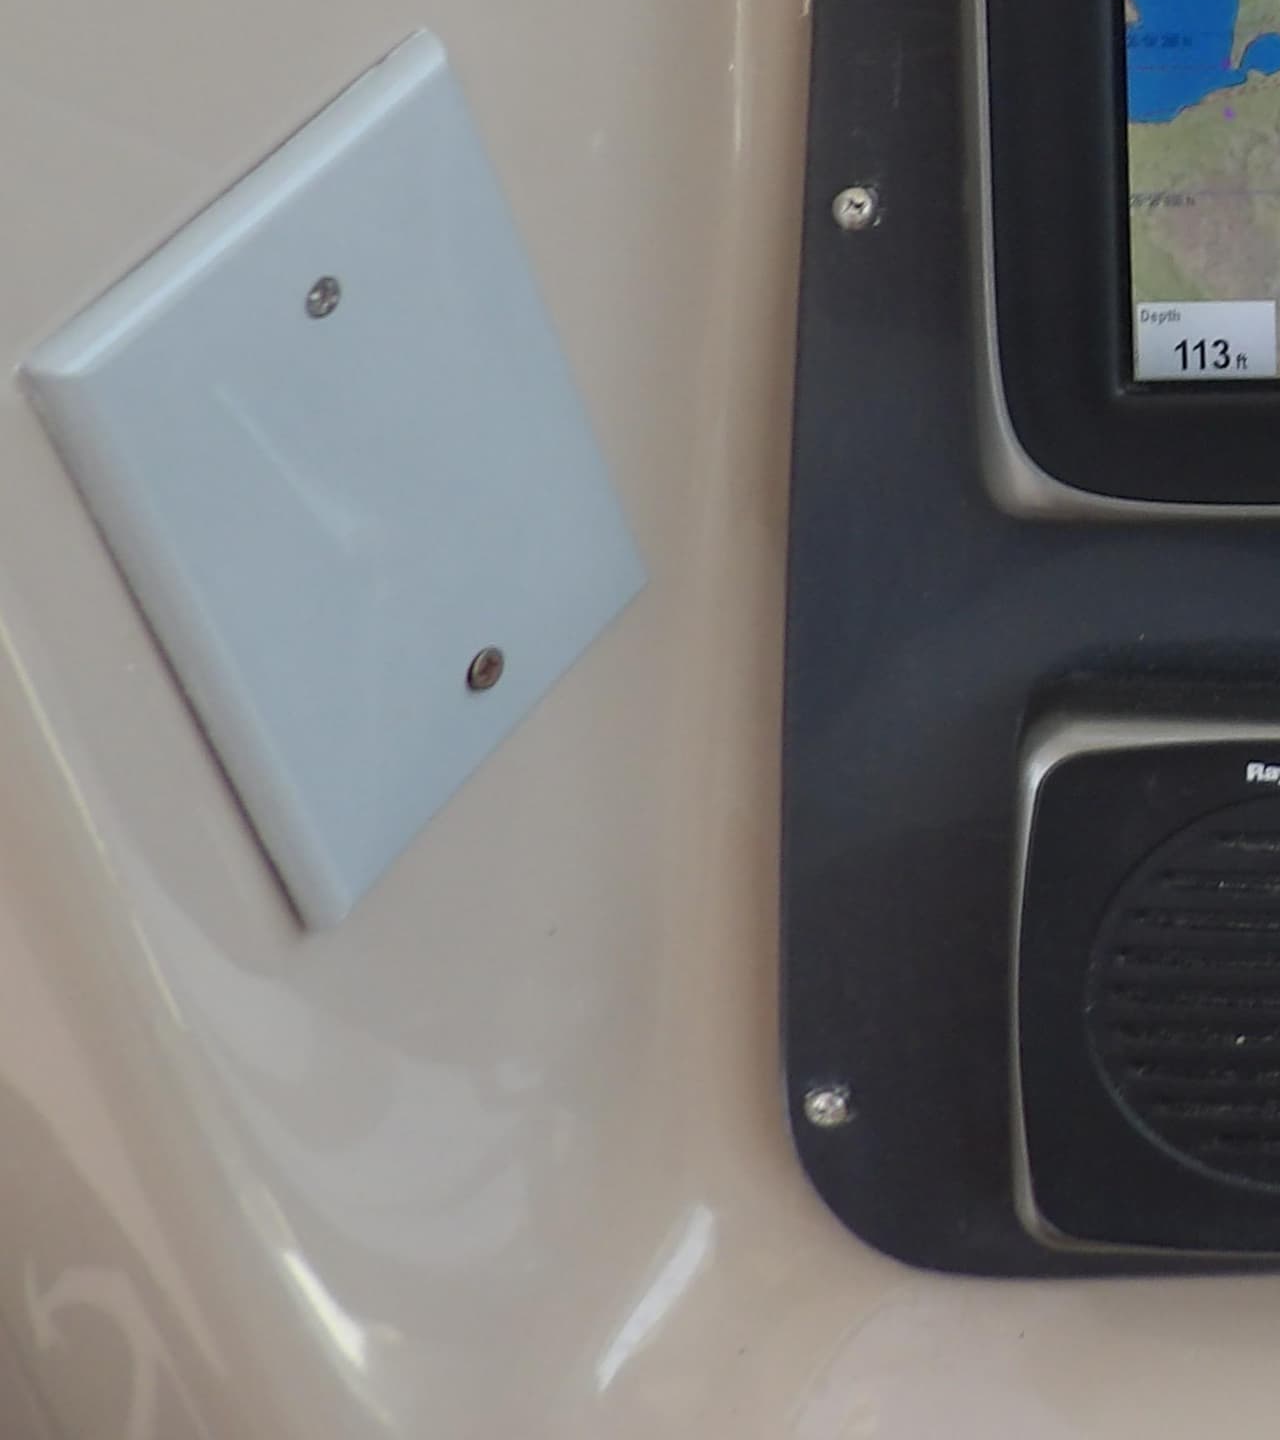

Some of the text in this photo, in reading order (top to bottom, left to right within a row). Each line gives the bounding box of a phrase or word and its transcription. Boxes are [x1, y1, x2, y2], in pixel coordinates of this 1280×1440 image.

[1140, 310, 1182, 325] Depth
[1174, 338, 1249, 371] 113 ft
